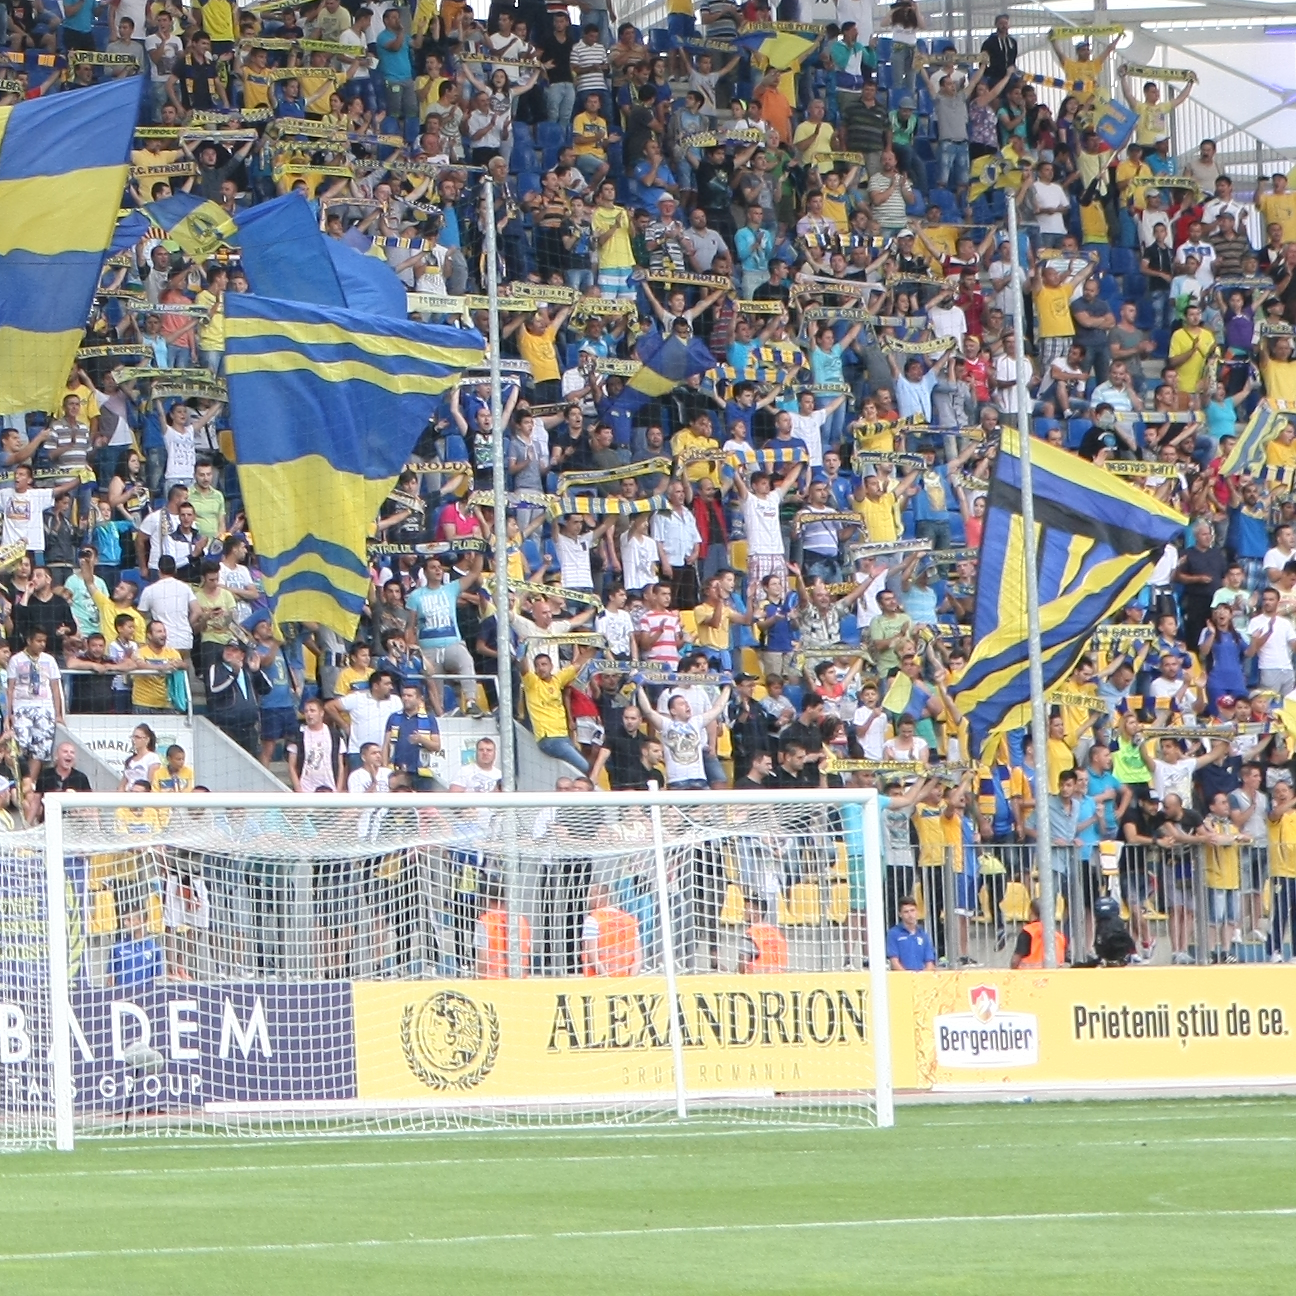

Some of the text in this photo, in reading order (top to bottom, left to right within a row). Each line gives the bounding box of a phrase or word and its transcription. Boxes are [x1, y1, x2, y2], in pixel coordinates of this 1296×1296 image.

[546, 988, 870, 1051] ALEXANDRION
[1074, 1002, 1289, 1048] Prietenii știu de ce.
[939, 1023, 1034, 1056] Bergenbier
[699, 1062, 802, 1083] ROMANIA
